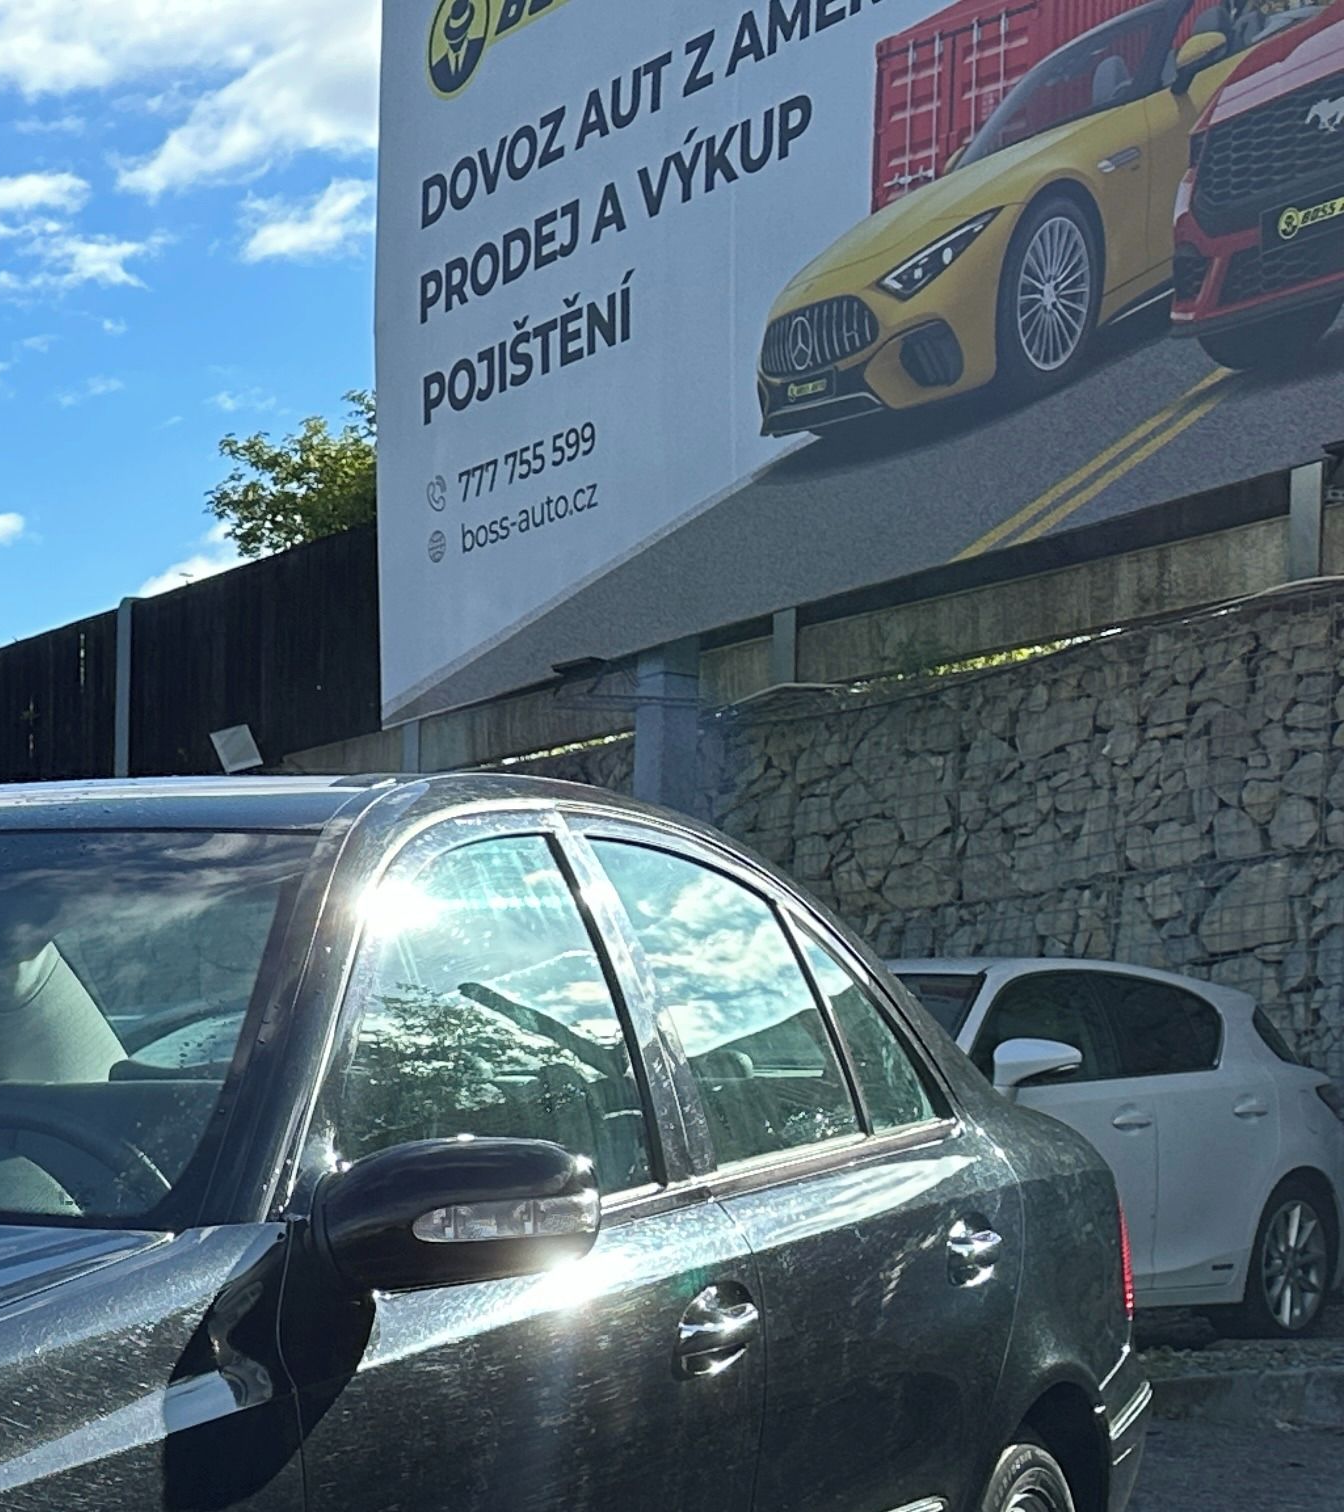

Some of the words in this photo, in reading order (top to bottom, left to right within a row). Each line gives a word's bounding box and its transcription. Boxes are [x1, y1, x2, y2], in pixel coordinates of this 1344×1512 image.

[421, 105, 566, 230] DOVOZ
[575, 51, 672, 151] AUT
[683, 29, 715, 97] Z
[725, 0, 883, 78] AME
[420, 198, 580, 325] PRODEJ
[591, 182, 627, 244] A
[637, 94, 812, 218] VÝKUP
[423, 268, 635, 426] POJIŠTĚNÍ
[458, 458, 499, 503] 777
[504, 440, 545, 485] 755
[551, 421, 596, 467] 599
[461, 483, 599, 554] boss-auto.cz
